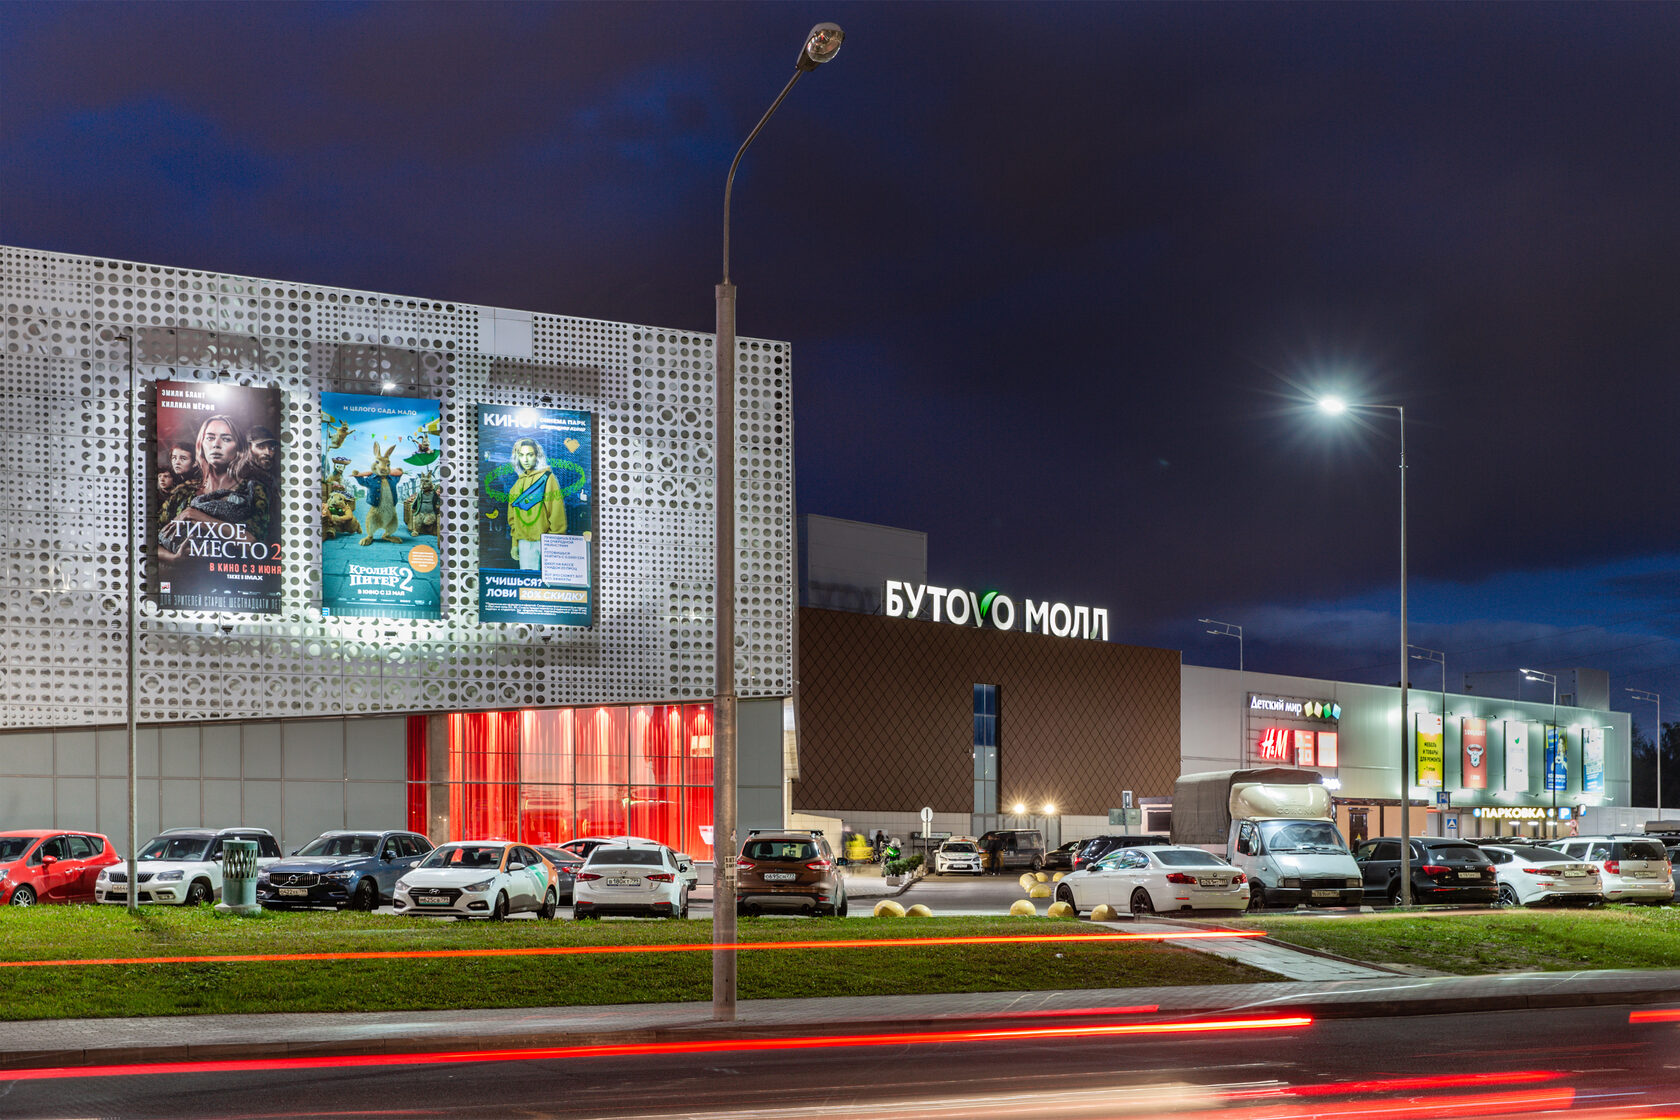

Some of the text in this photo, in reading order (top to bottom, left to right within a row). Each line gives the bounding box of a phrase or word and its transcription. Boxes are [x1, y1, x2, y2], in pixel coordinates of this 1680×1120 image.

[161, 389, 206, 399] ЭМИЛИ БЛАНТ
[161, 400, 191, 409] КИЛЛИАН
[567, 419, 586, 427] ПАРК
[170, 520, 247, 540] ТИХОЕ
[188, 539, 283, 560] МЕСТО 2
[209, 562, 282, 575] В КИНО С 3 ИЮНЯ
[349, 567, 414, 592] ПИТЕР 2
[485, 576, 542, 587] УЧИШЬСЯ?
[174, 594, 202, 607] ЗРИТЕЛЕЙ
[204, 595, 226, 608] СТАРШЕ
[486, 588, 517, 599] ЛОВИ
[543, 591, 585, 602] СКИДКУ
[1025, 598, 1109, 641] МОЛЛ
[1250, 696, 1302, 716] Детский мир
[1261, 728, 1289, 760] H&M
[1481, 807, 1546, 818] ПАРКОВКА
